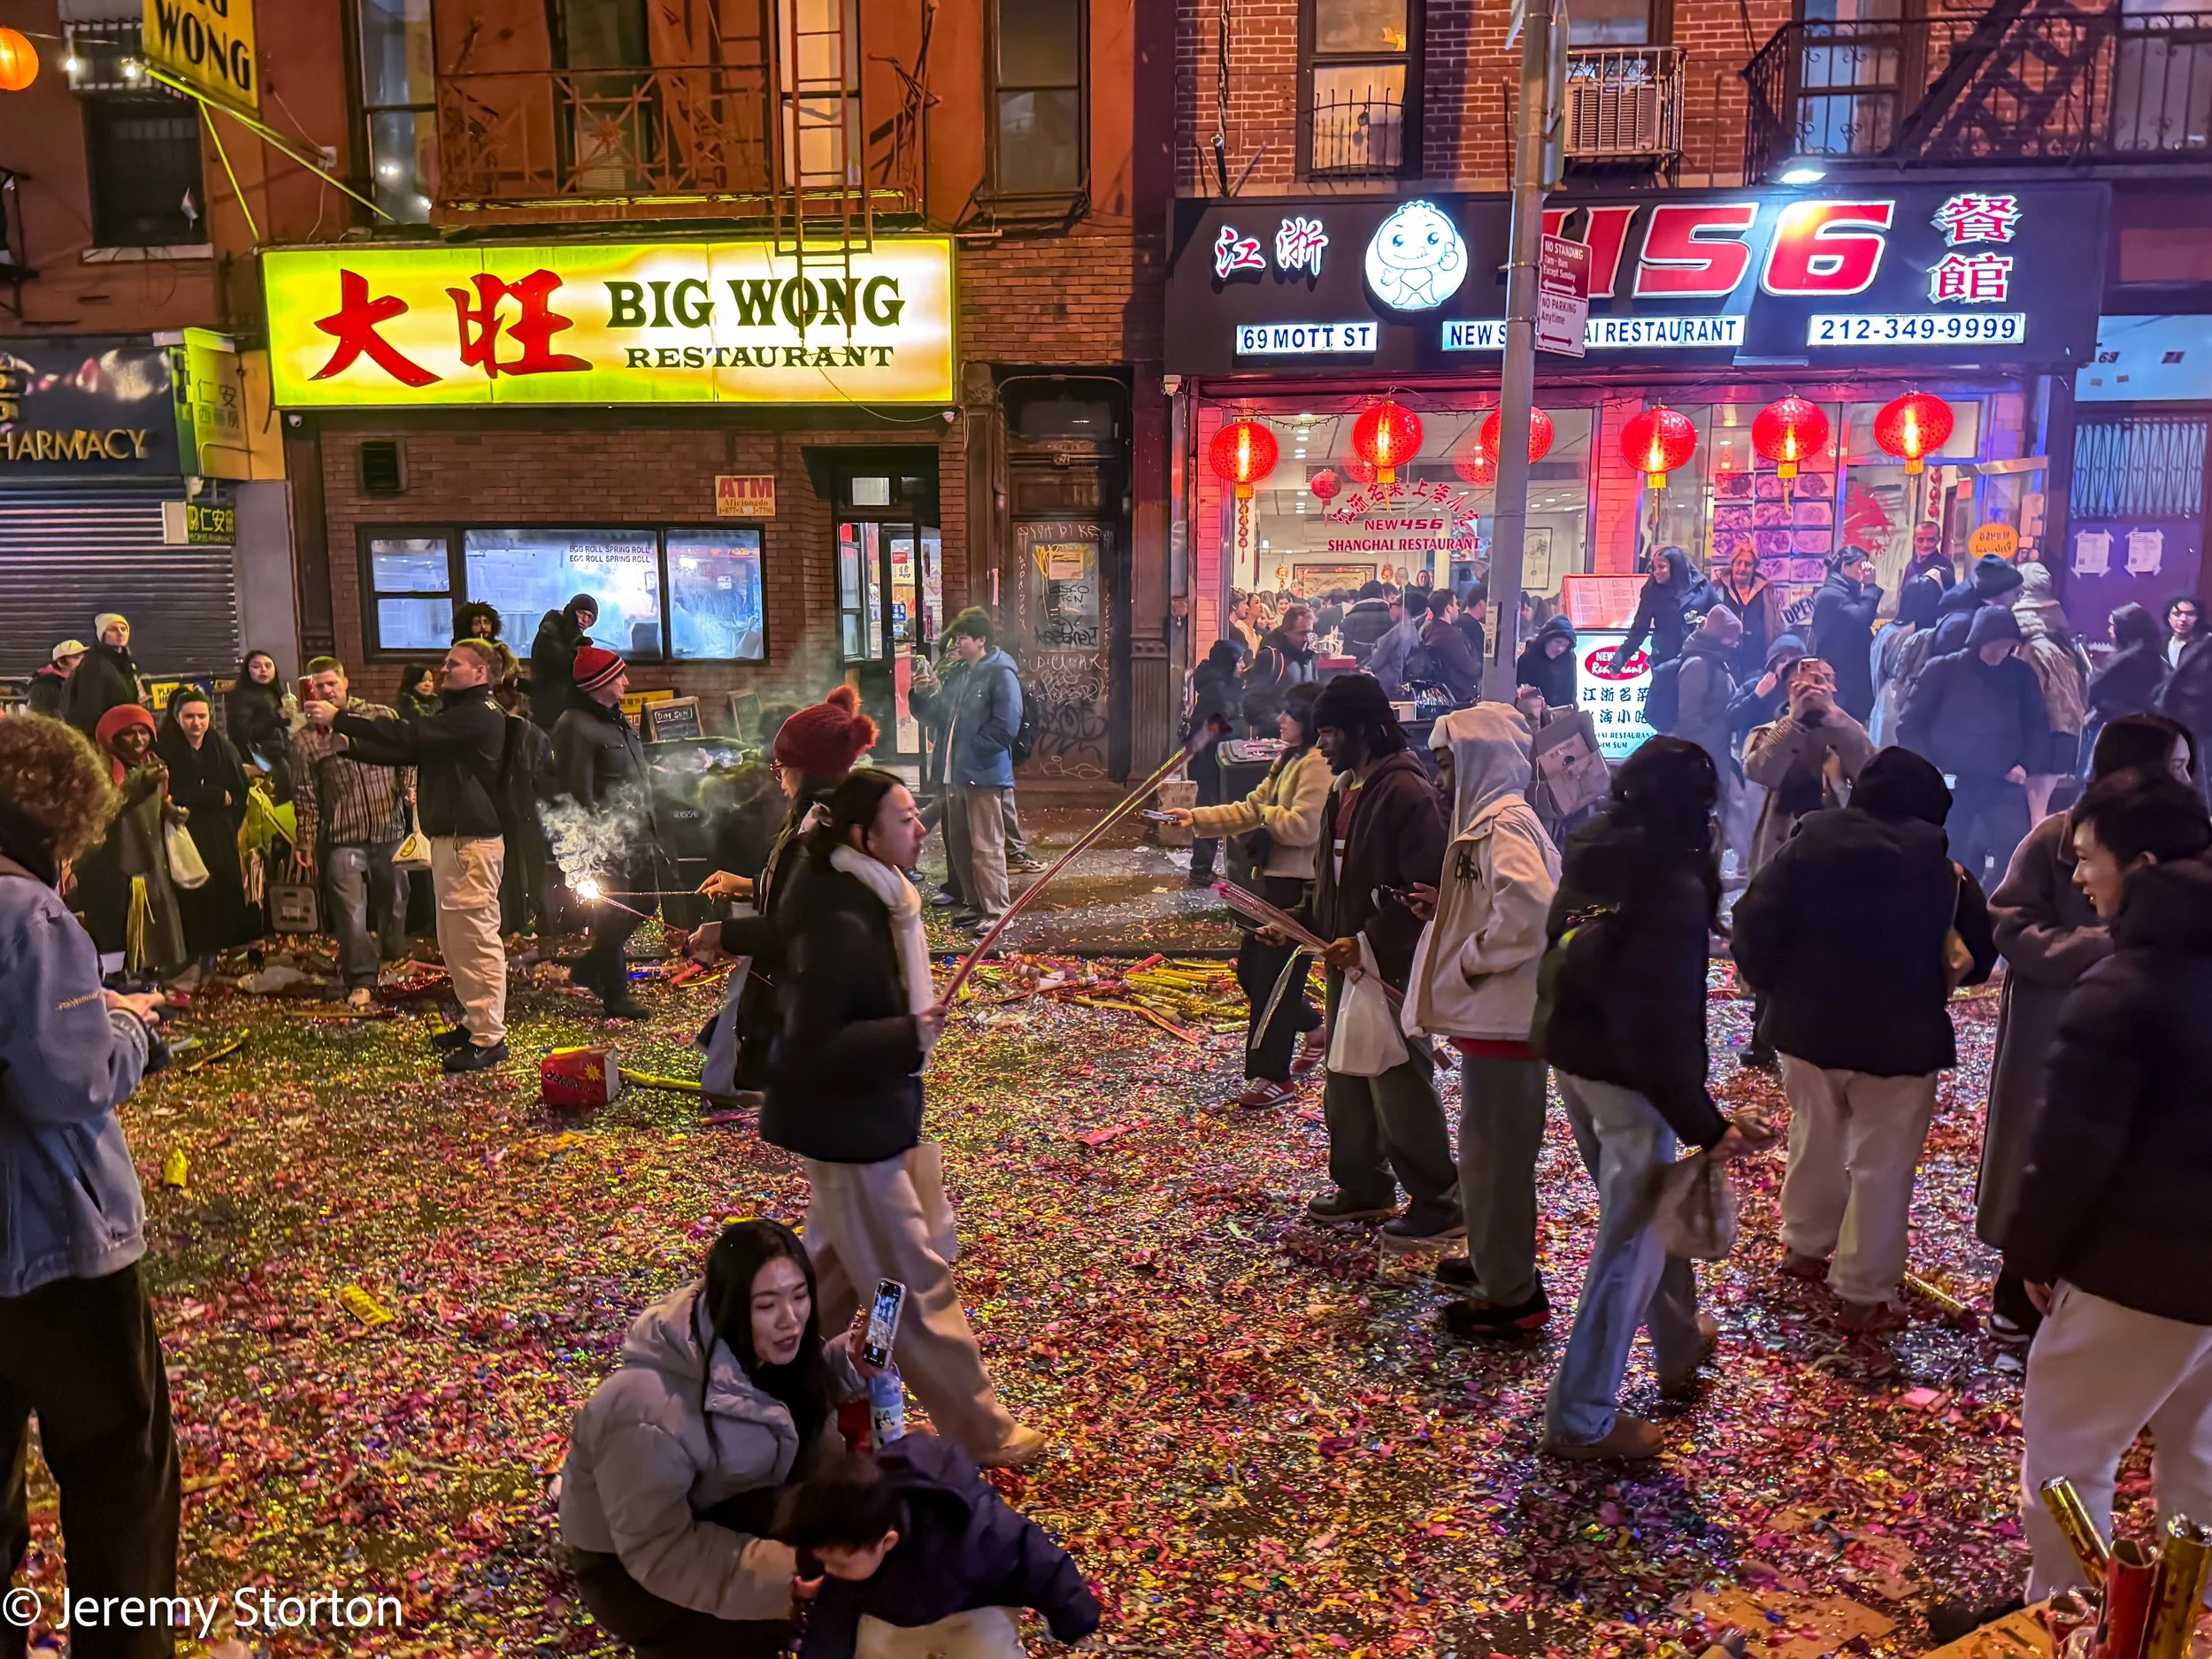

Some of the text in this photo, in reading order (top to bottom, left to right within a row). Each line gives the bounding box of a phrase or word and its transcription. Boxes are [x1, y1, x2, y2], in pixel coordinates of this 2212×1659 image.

[156, 0, 250, 91] WONG
[1545, 240, 1584, 260] NO STANDING
[1932, 193, 2019, 303] 餐館
[1543, 264, 1576, 283] Except Sunday
[603, 275, 905, 328] BIG WONG
[1541, 297, 1577, 314] NO PARKING
[307, 268, 594, 388] 大旺
[1541, 311, 1565, 325] Anytime
[1244, 326, 1371, 349] 69 MOTT ST
[1450, 324, 1493, 346] NEW
[1605, 319, 1737, 342] RESTAURANT
[1820, 318, 2016, 340] 212-349-9999
[624, 345, 894, 369] RESTAURANT
[718, 477, 772, 498] ATM
[725, 498, 768, 507] Aficionado
[1364, 518, 1444, 531] NEW 456
[605, 545, 631, 554] SPRING
[1327, 537, 1480, 551] SHANGHAI RESTAURANT
[605, 555, 631, 564] SPRING
[1592, 709, 1648, 724] 海小吃
